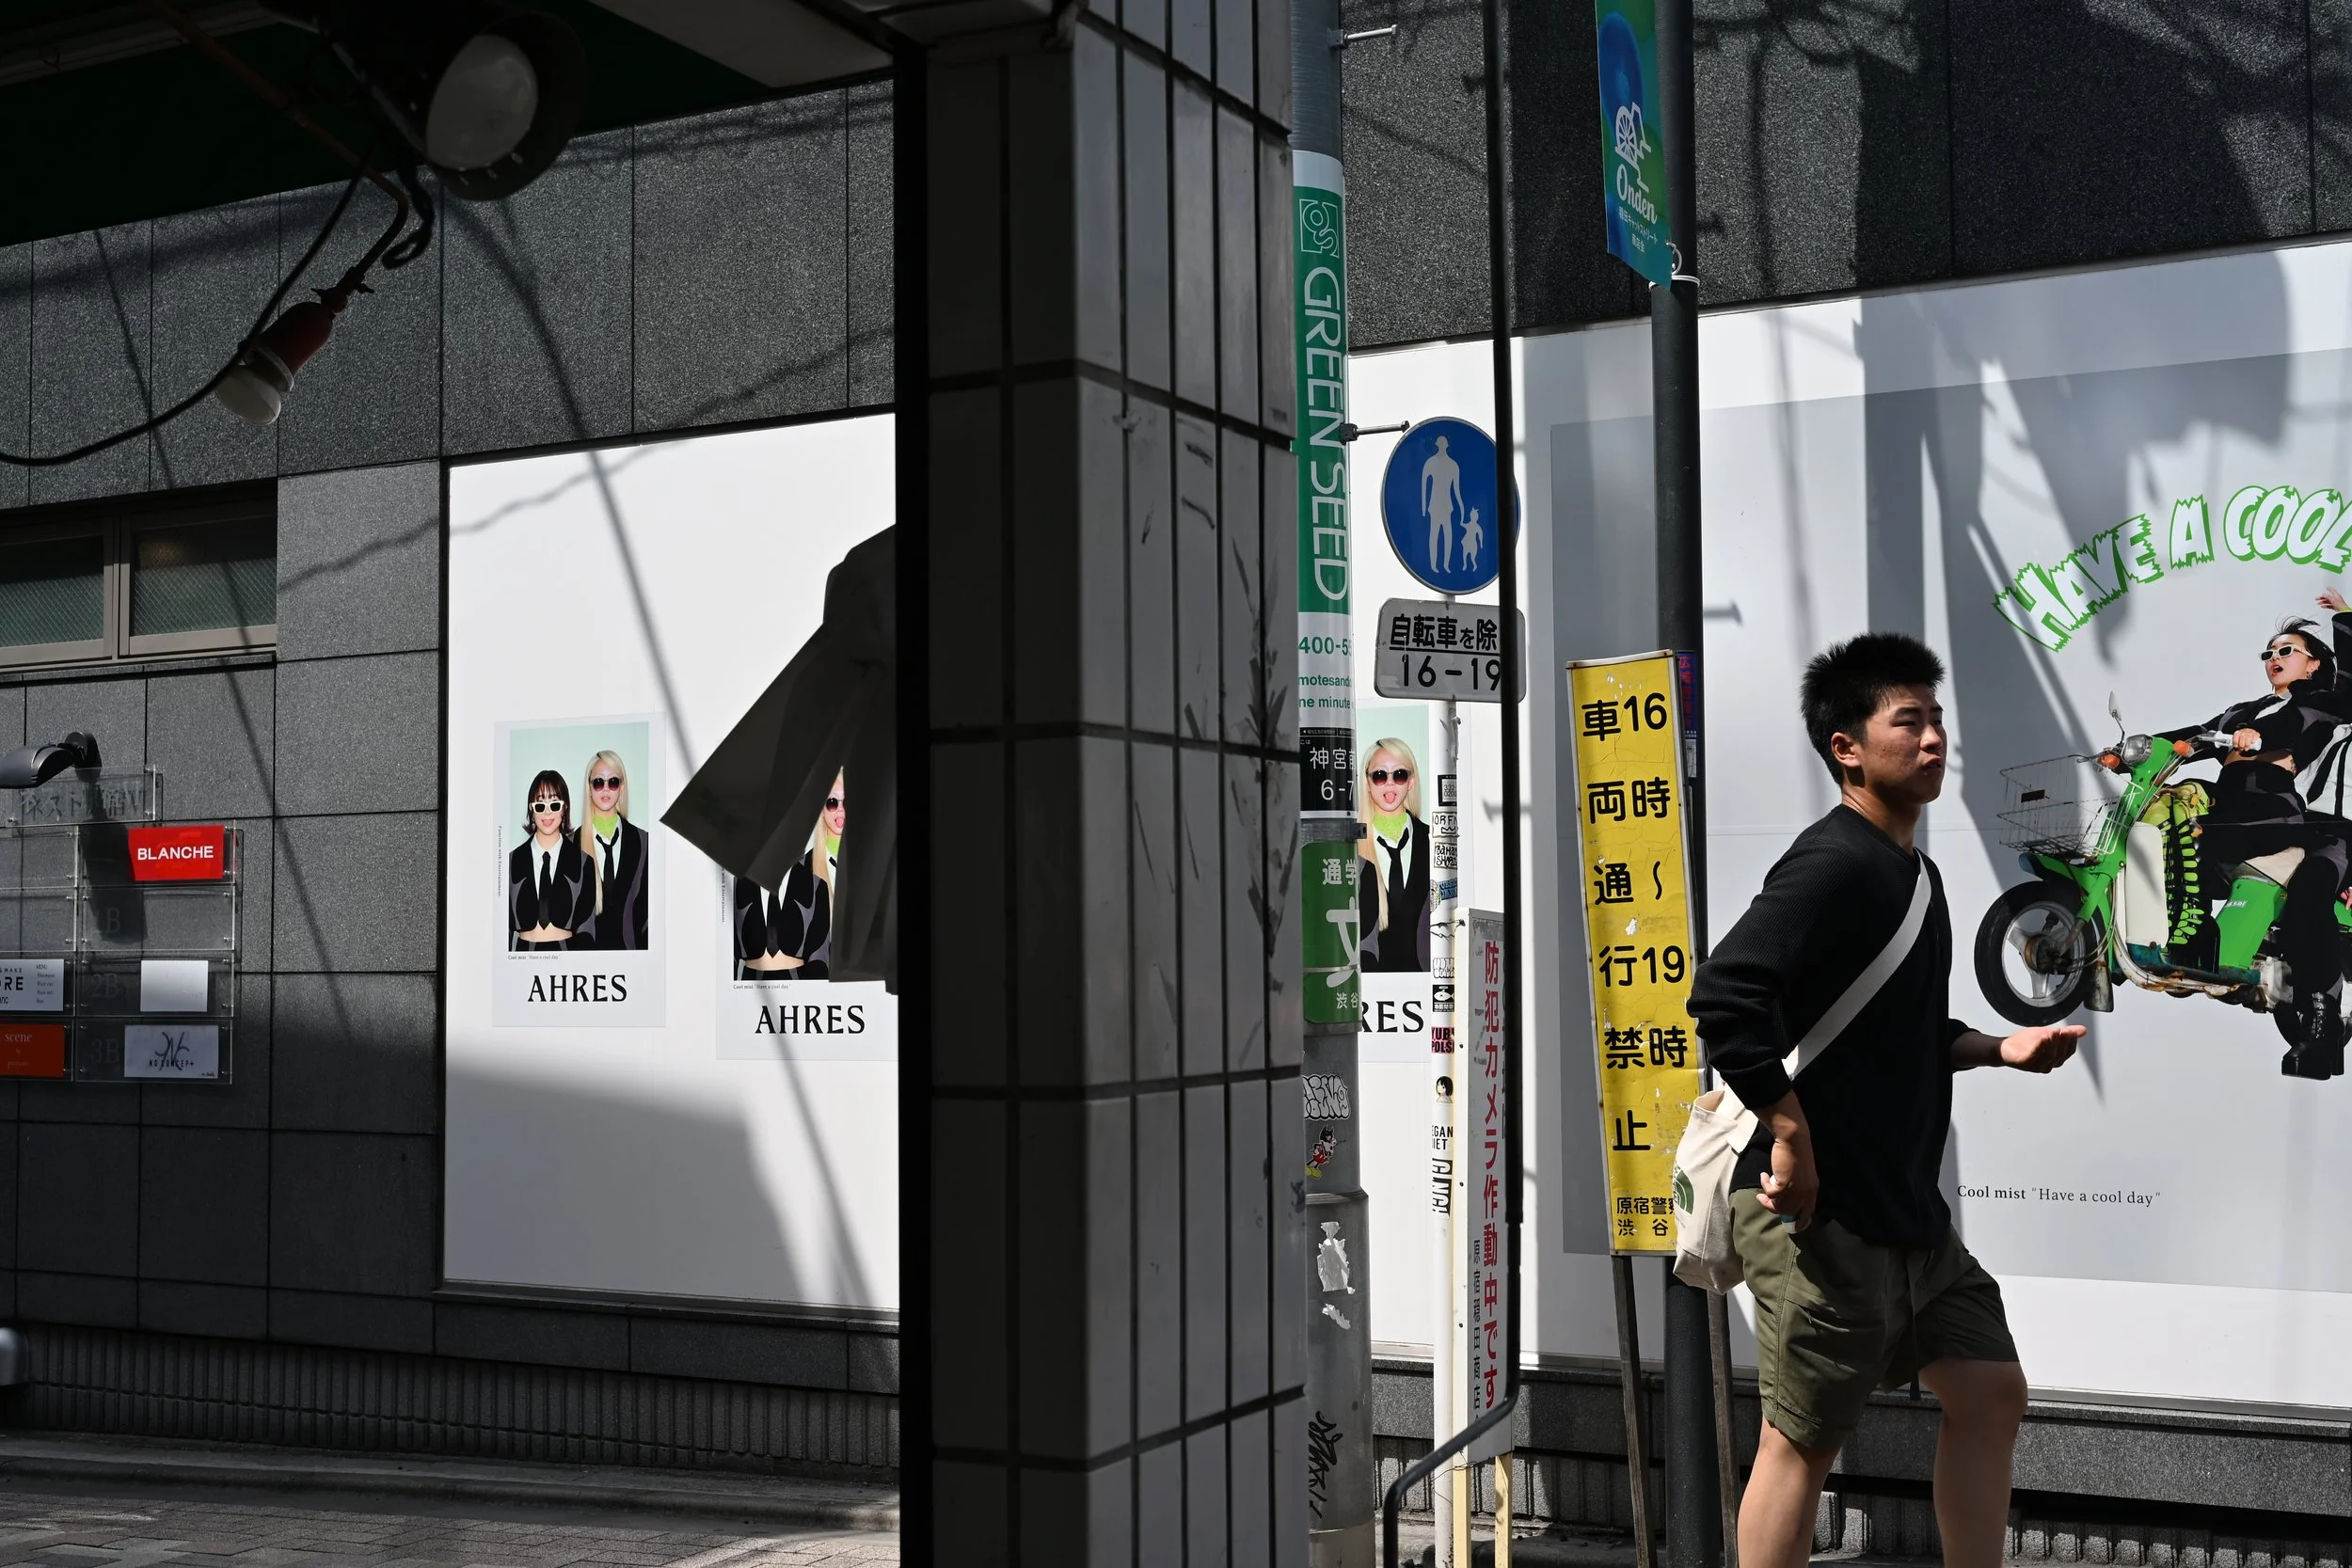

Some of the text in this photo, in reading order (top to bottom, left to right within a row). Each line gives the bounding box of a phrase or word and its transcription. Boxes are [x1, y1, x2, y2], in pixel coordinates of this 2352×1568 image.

[1616, 164, 1658, 225] Onden
[1305, 266, 1345, 447] GREEN
[1311, 461, 1349, 600] SEED
[1992, 514, 2164, 653] HAVE
[2169, 494, 2215, 570] A
[1391, 613, 1497, 651] 自転車を除
[1402, 654, 1500, 691] 16-19
[1319, 696, 1350, 709] minute
[1321, 780, 1354, 800] 6-7
[137, 846, 214, 861] BLANCHE
[1581, 699, 1651, 1150] 車両通行禁止
[0, 976, 24, 990] RE
[527, 974, 628, 1003] AHRES
[755, 1005, 866, 1035] AHRES
[5, 1033, 33, 1043] scene
[1484, 941, 1500, 1409] 防犯カメラ作動中です
[1957, 1185, 1990, 1198] Cool
[1994, 1187, 2026, 1199] mist
[2079, 1193, 2087, 1202] a
[2091, 1191, 2122, 1203] cool
